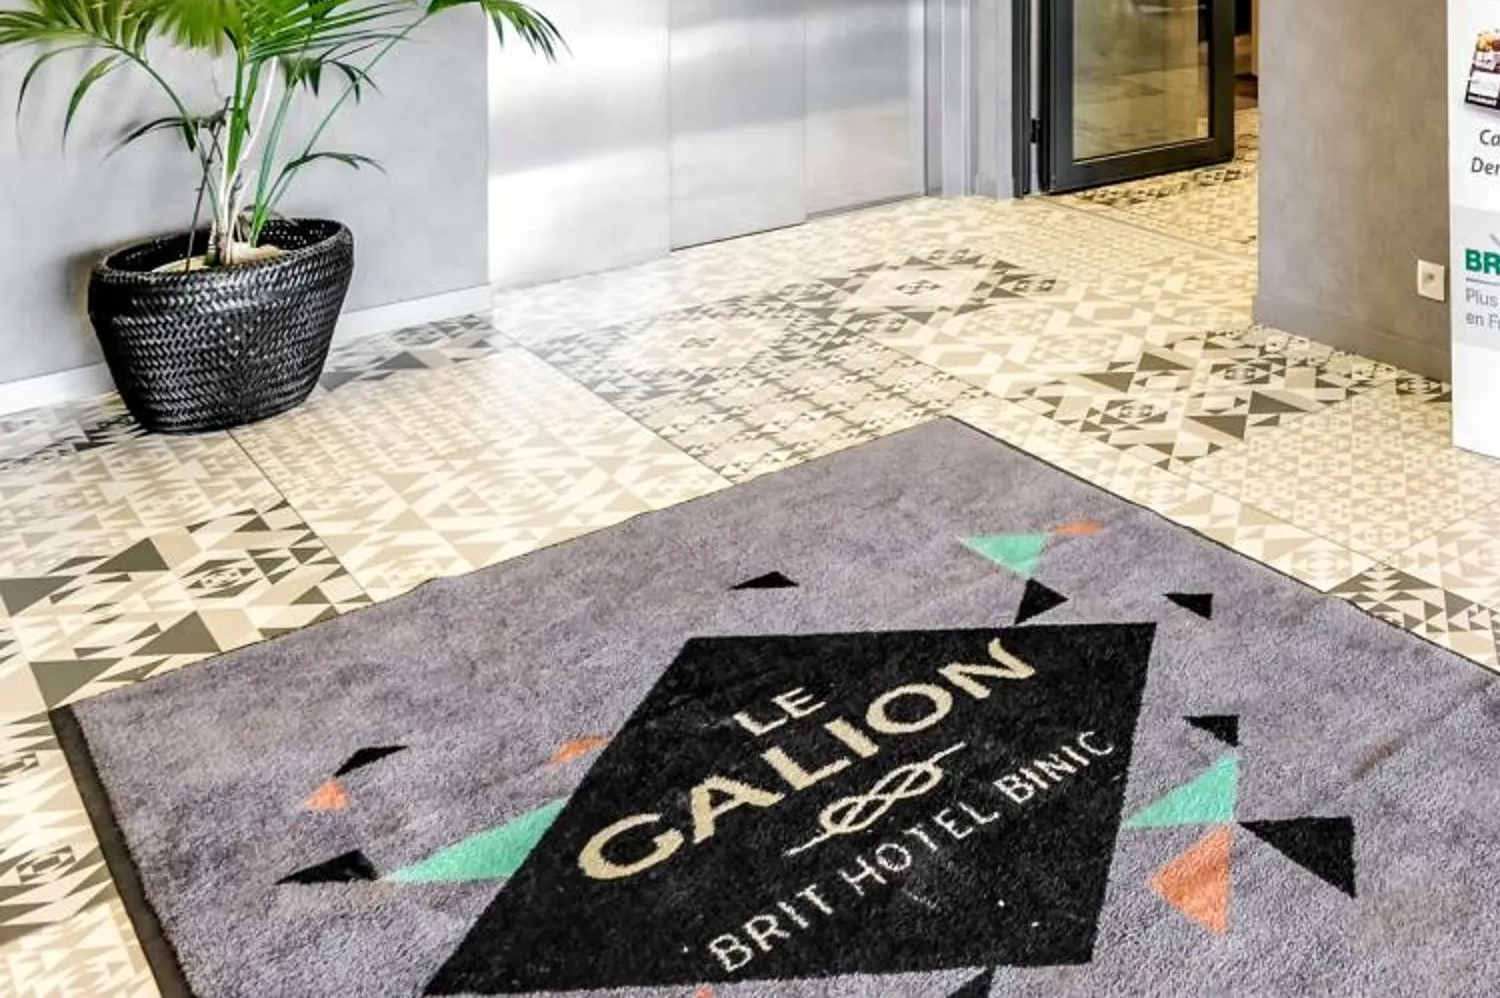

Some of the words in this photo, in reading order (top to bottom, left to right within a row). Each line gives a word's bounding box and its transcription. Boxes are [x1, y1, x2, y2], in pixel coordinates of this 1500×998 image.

[1465, 287, 1499, 309] Plus
[1465, 313, 1485, 326] en
[732, 685, 827, 738] LE
[708, 885, 834, 973] BRIT
[840, 798, 1000, 898] HOTEL
[992, 729, 1116, 806] BINIC
